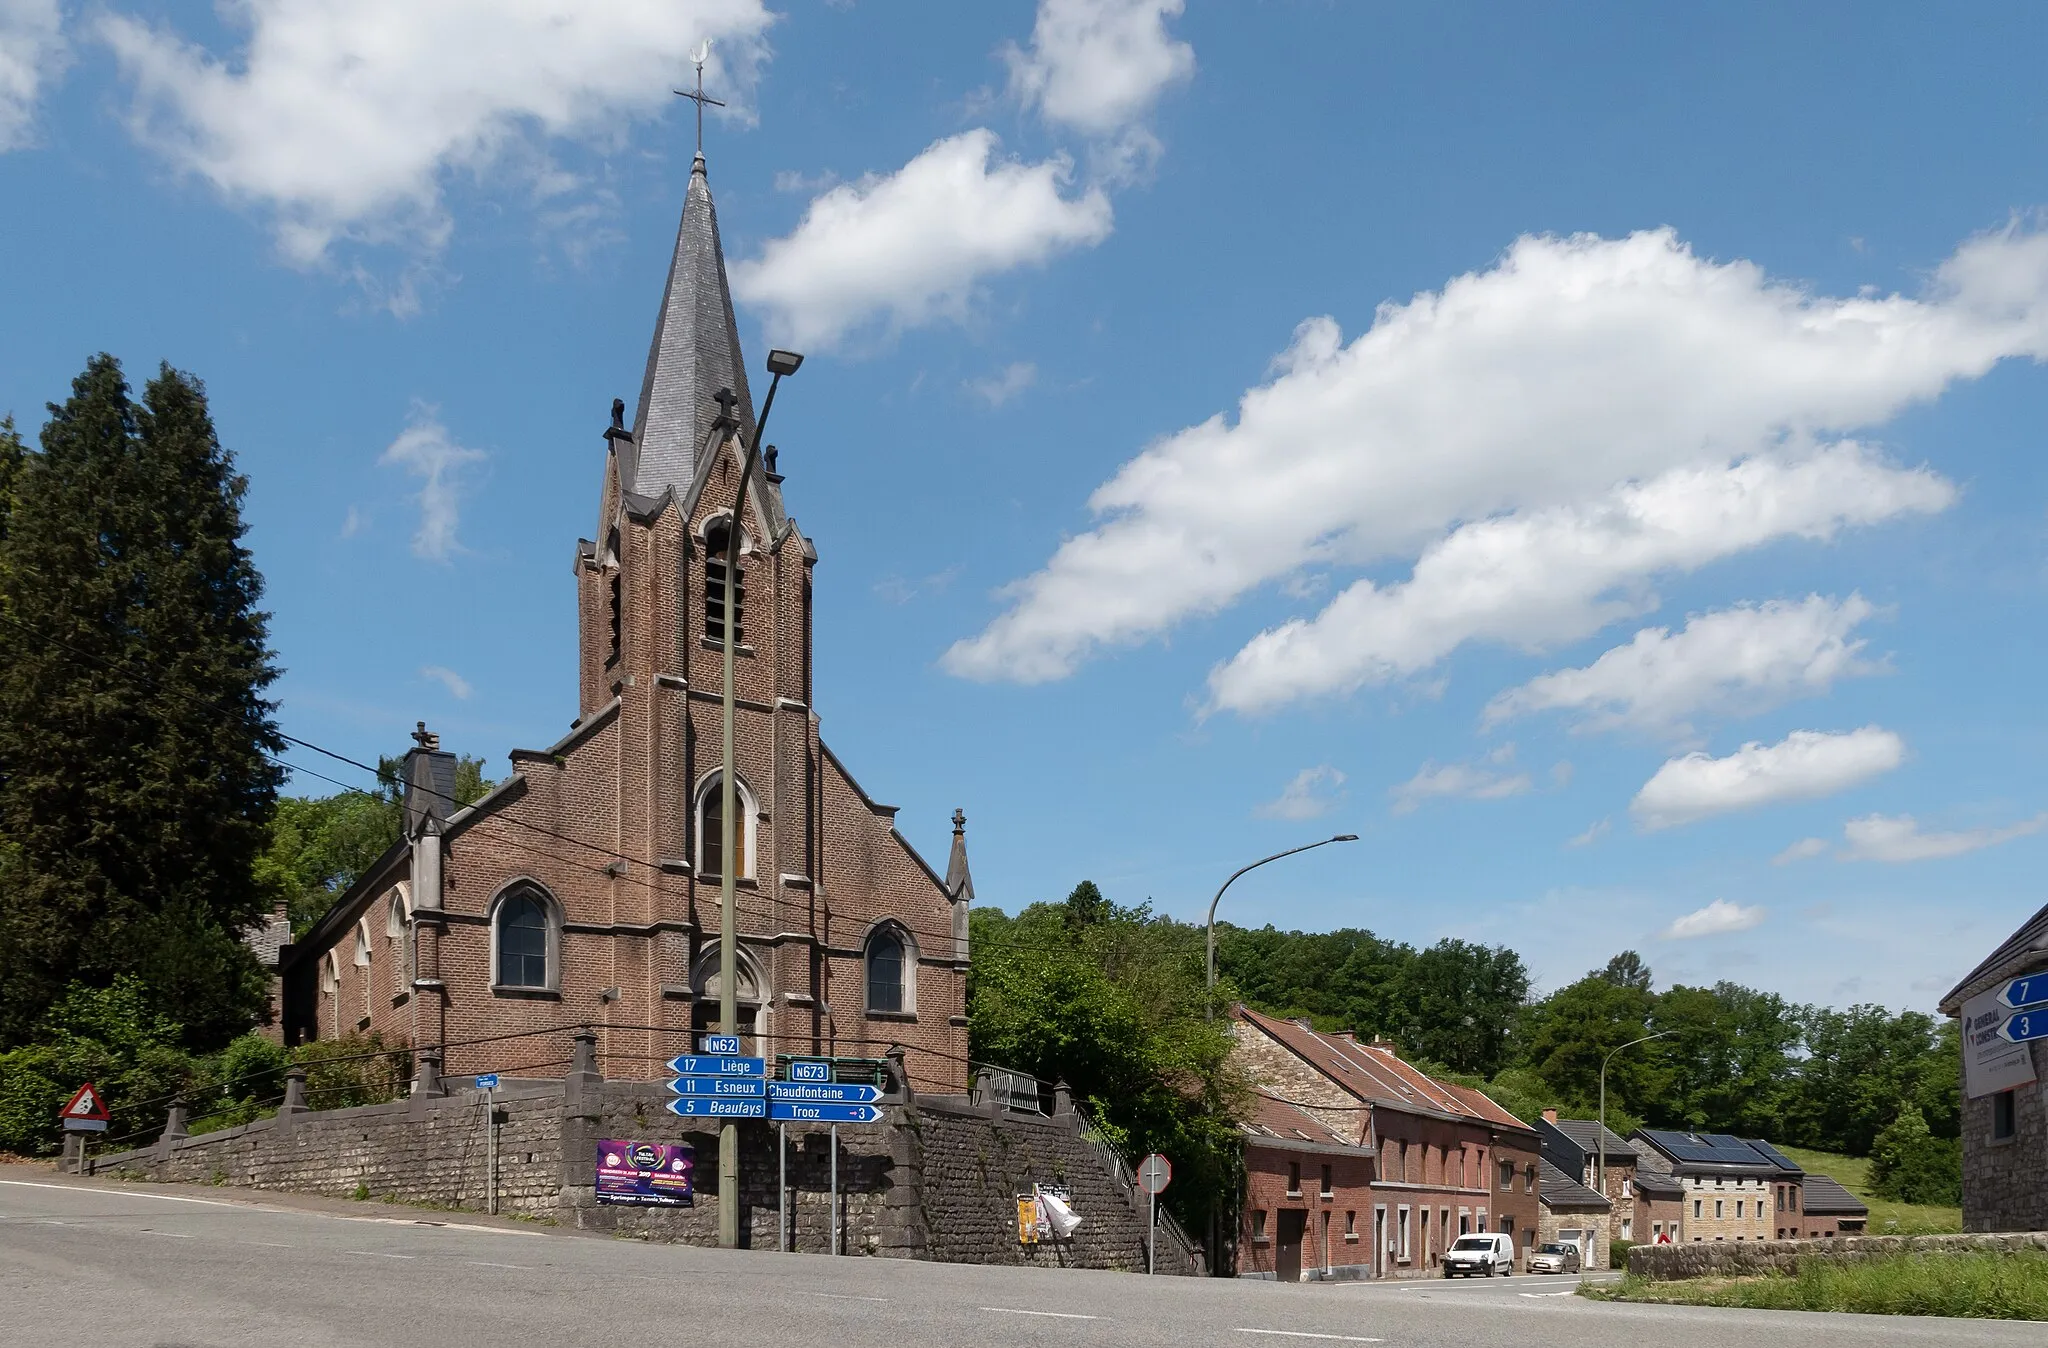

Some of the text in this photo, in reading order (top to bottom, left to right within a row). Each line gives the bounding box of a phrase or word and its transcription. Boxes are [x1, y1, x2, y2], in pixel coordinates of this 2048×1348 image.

[2020, 981, 2029, 1001] 7
[2020, 1016, 2029, 1036] 3
[712, 1039, 736, 1052] N62
[684, 1058, 750, 1076] 17 Liège
[796, 1067, 824, 1079] N673
[686, 1079, 756, 1094] 11 Esneux
[769, 1084, 866, 1100] Chaudfontaine 7
[686, 1100, 762, 1116] 5 Beaufays
[791, 1105, 866, 1120] Trooz 3
